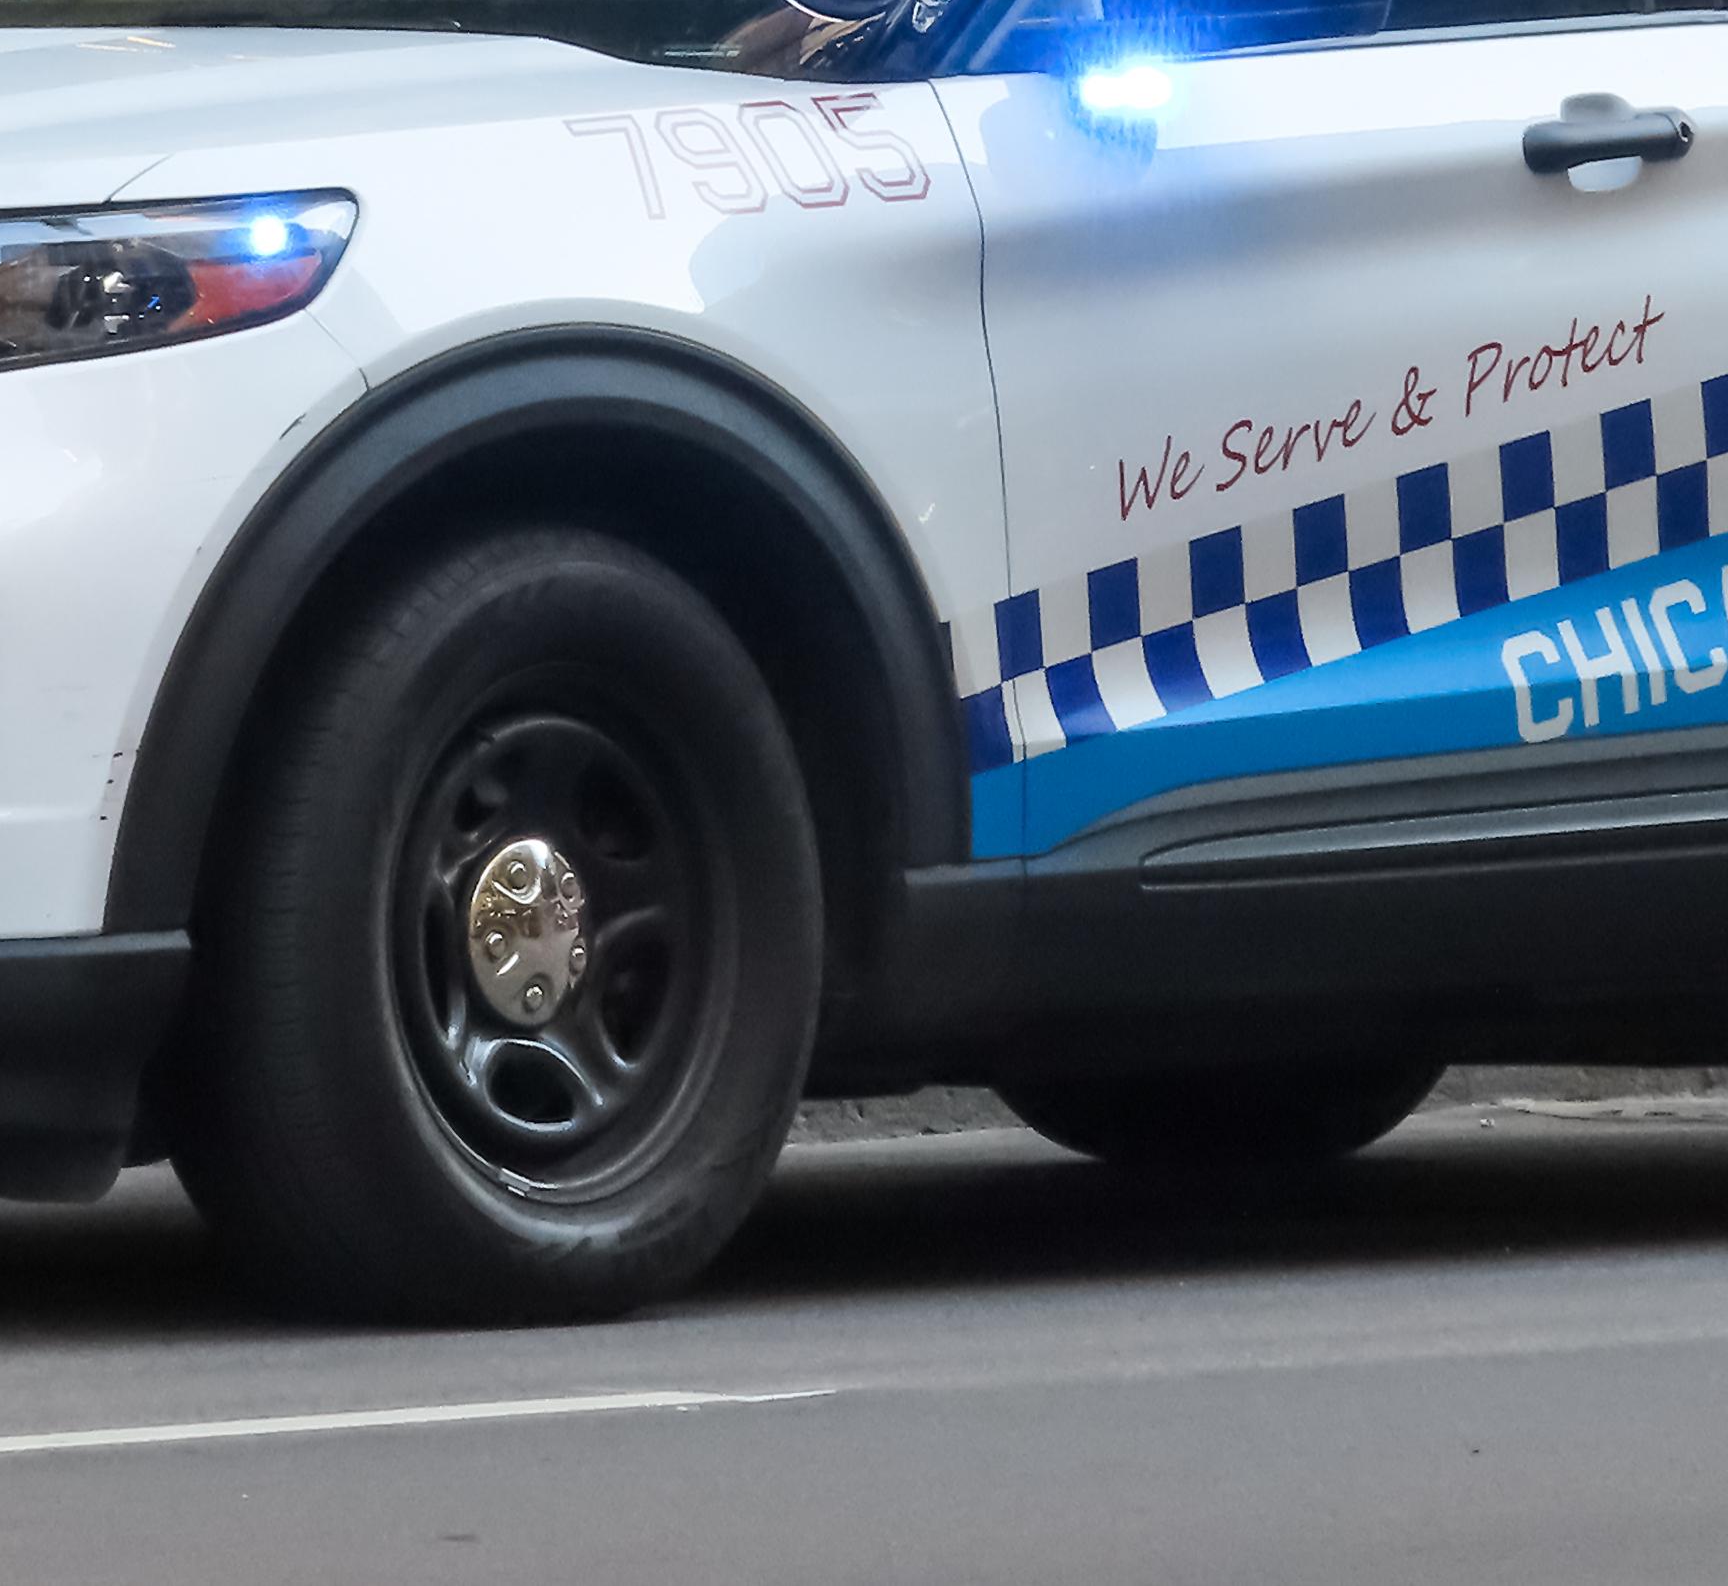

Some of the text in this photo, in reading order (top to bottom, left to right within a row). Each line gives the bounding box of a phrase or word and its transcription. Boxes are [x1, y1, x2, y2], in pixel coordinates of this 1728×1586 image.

[562, 91, 931, 220] 7905
[1119, 294, 1666, 521] We Serve & Protect
